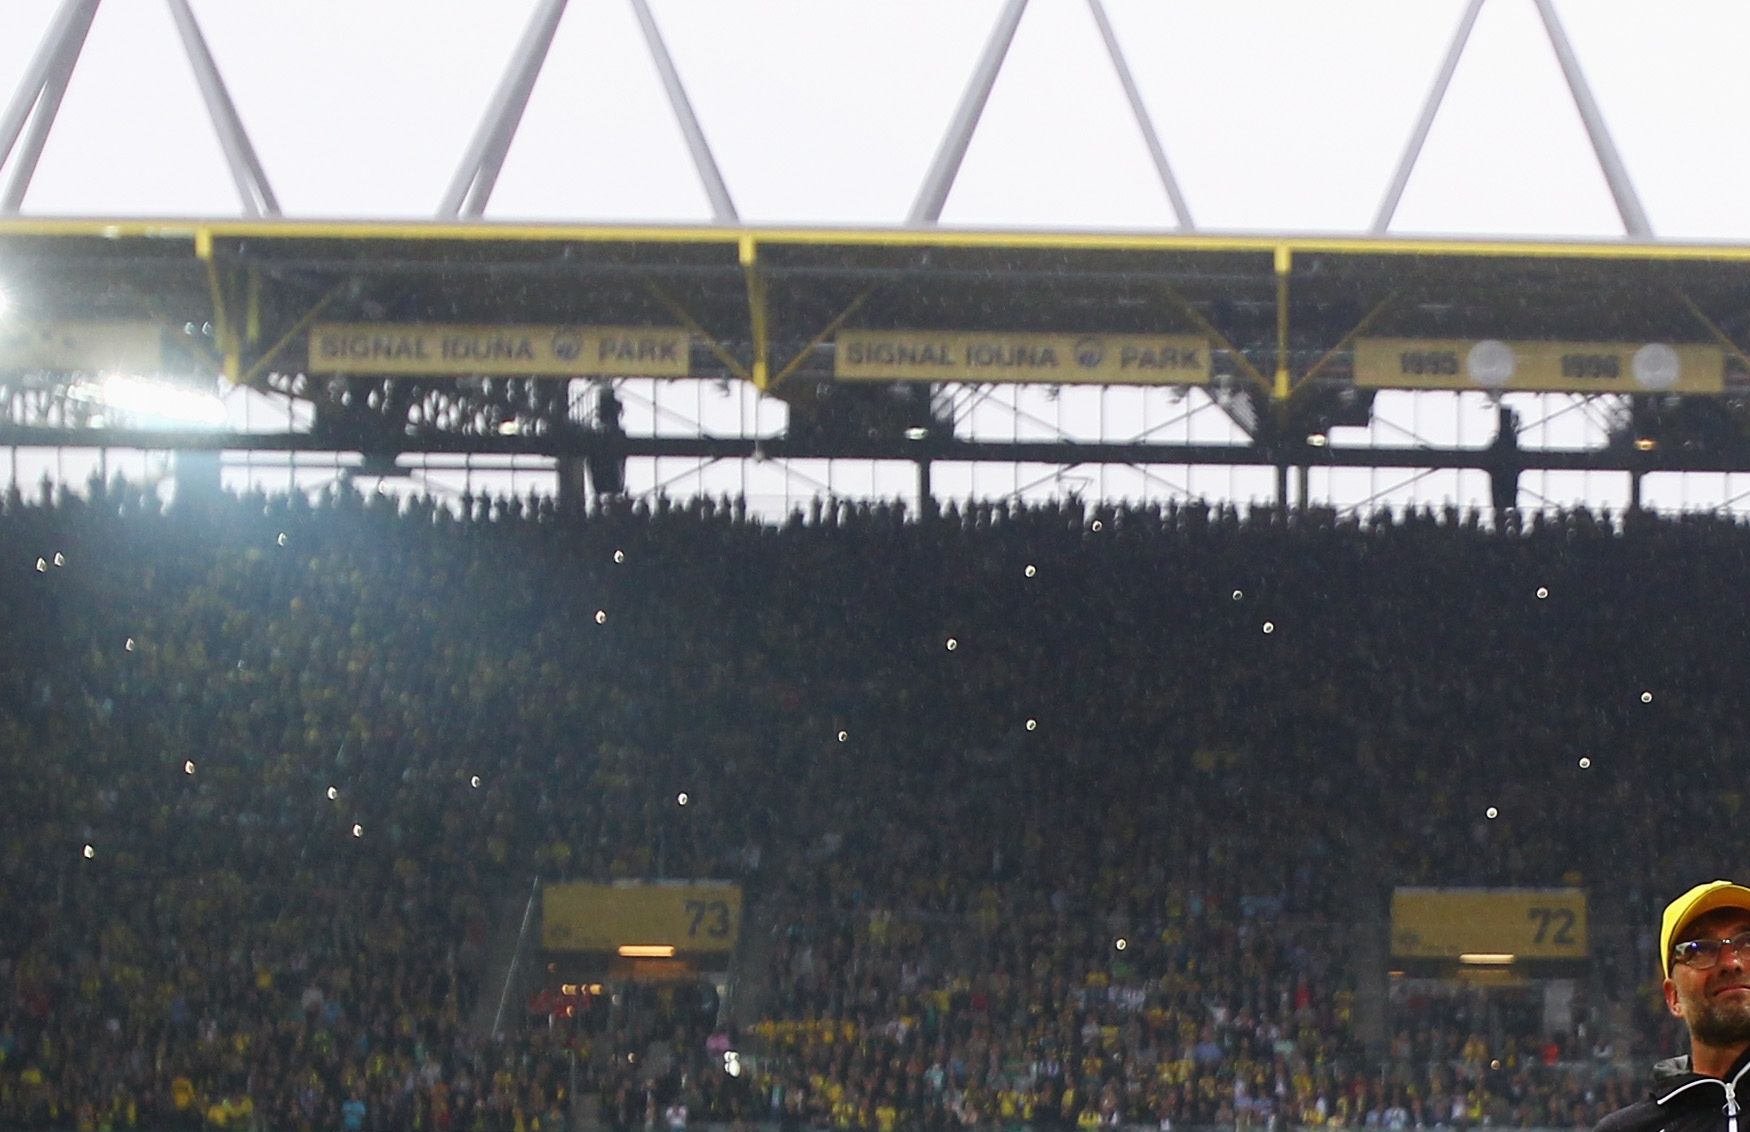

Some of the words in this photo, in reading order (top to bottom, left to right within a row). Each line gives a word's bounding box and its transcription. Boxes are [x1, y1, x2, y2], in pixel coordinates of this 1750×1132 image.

[319, 335, 429, 361] SIGNAL
[442, 337, 535, 361] IDUNA
[600, 338, 678, 363] PARK
[683, 899, 730, 939] 73
[1526, 907, 1576, 946] 72
